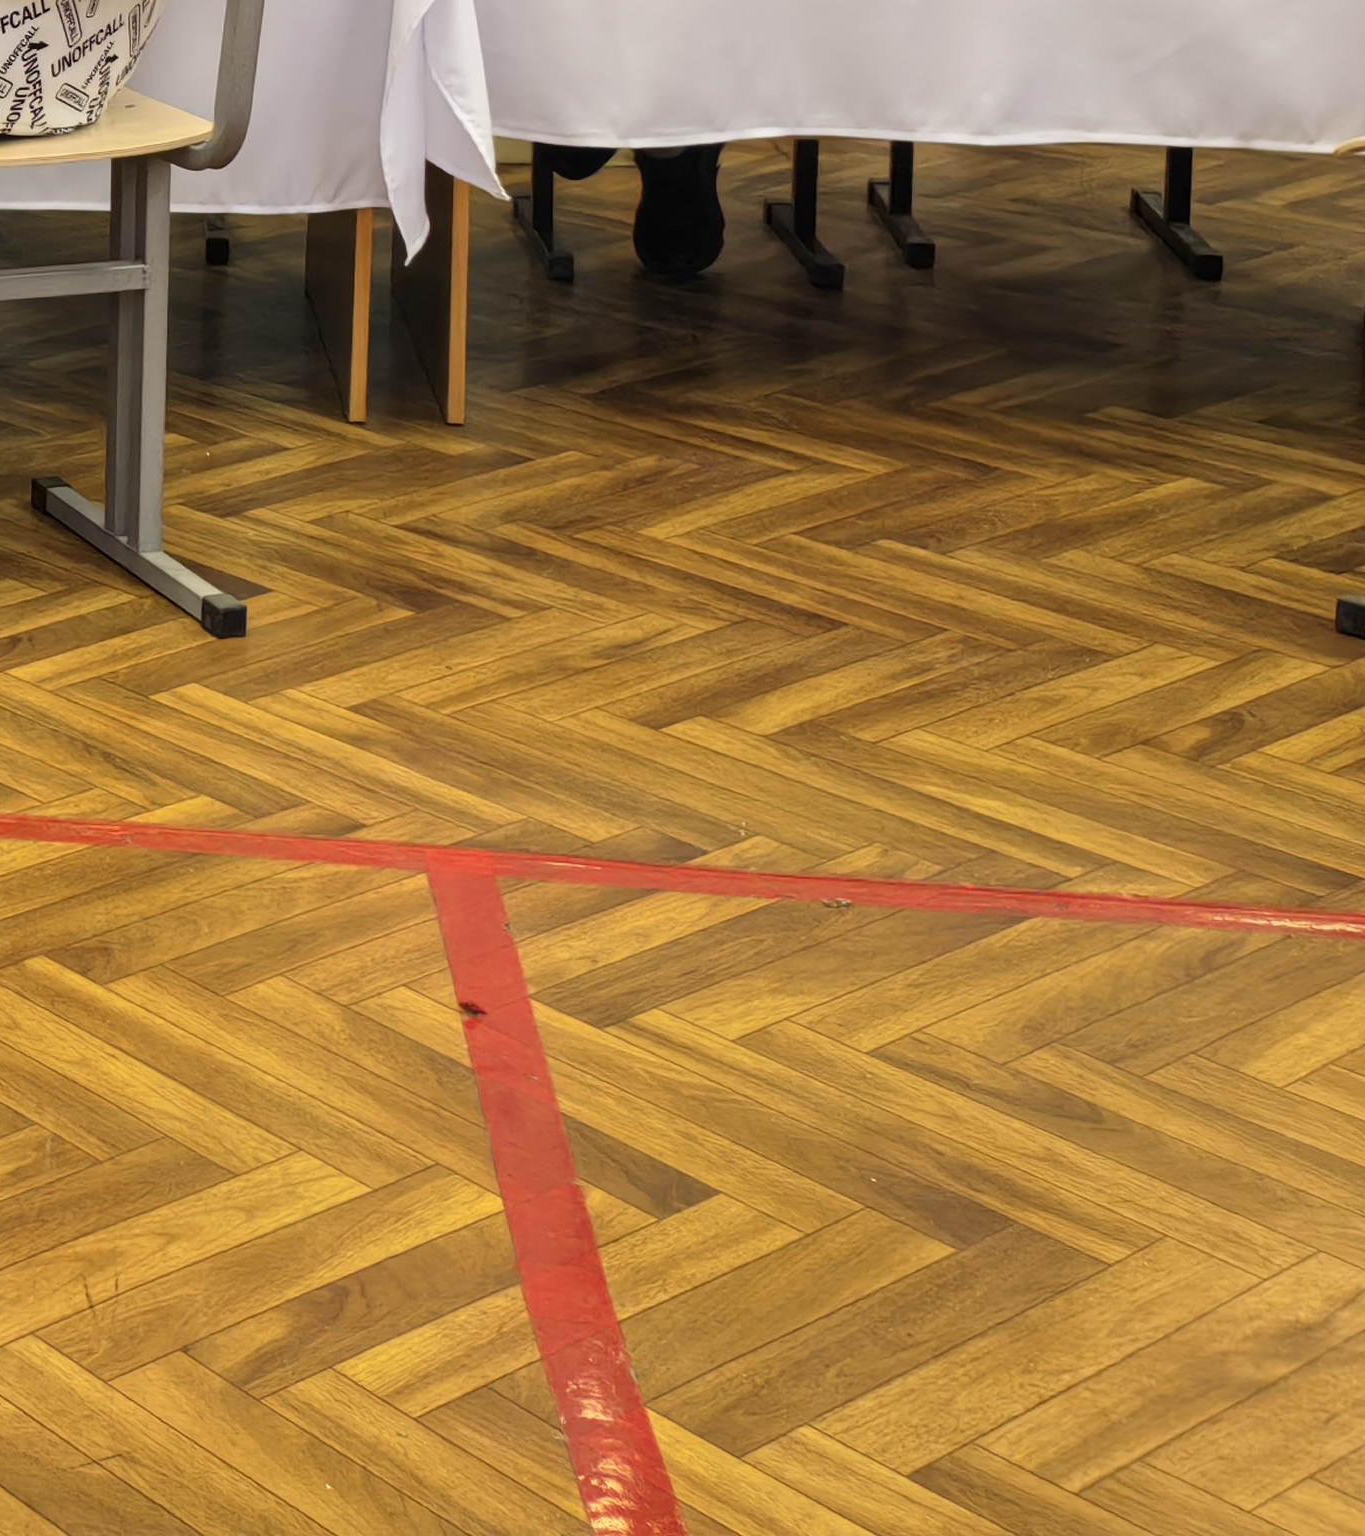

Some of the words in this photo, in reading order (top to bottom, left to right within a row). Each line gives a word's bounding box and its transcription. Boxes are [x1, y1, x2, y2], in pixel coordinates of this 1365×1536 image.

[0, 25, 40, 75] UNOFFCALL
[50, 13, 125, 78] UNOFFCALL
[81, 40, 114, 90] UNOFFCALL
